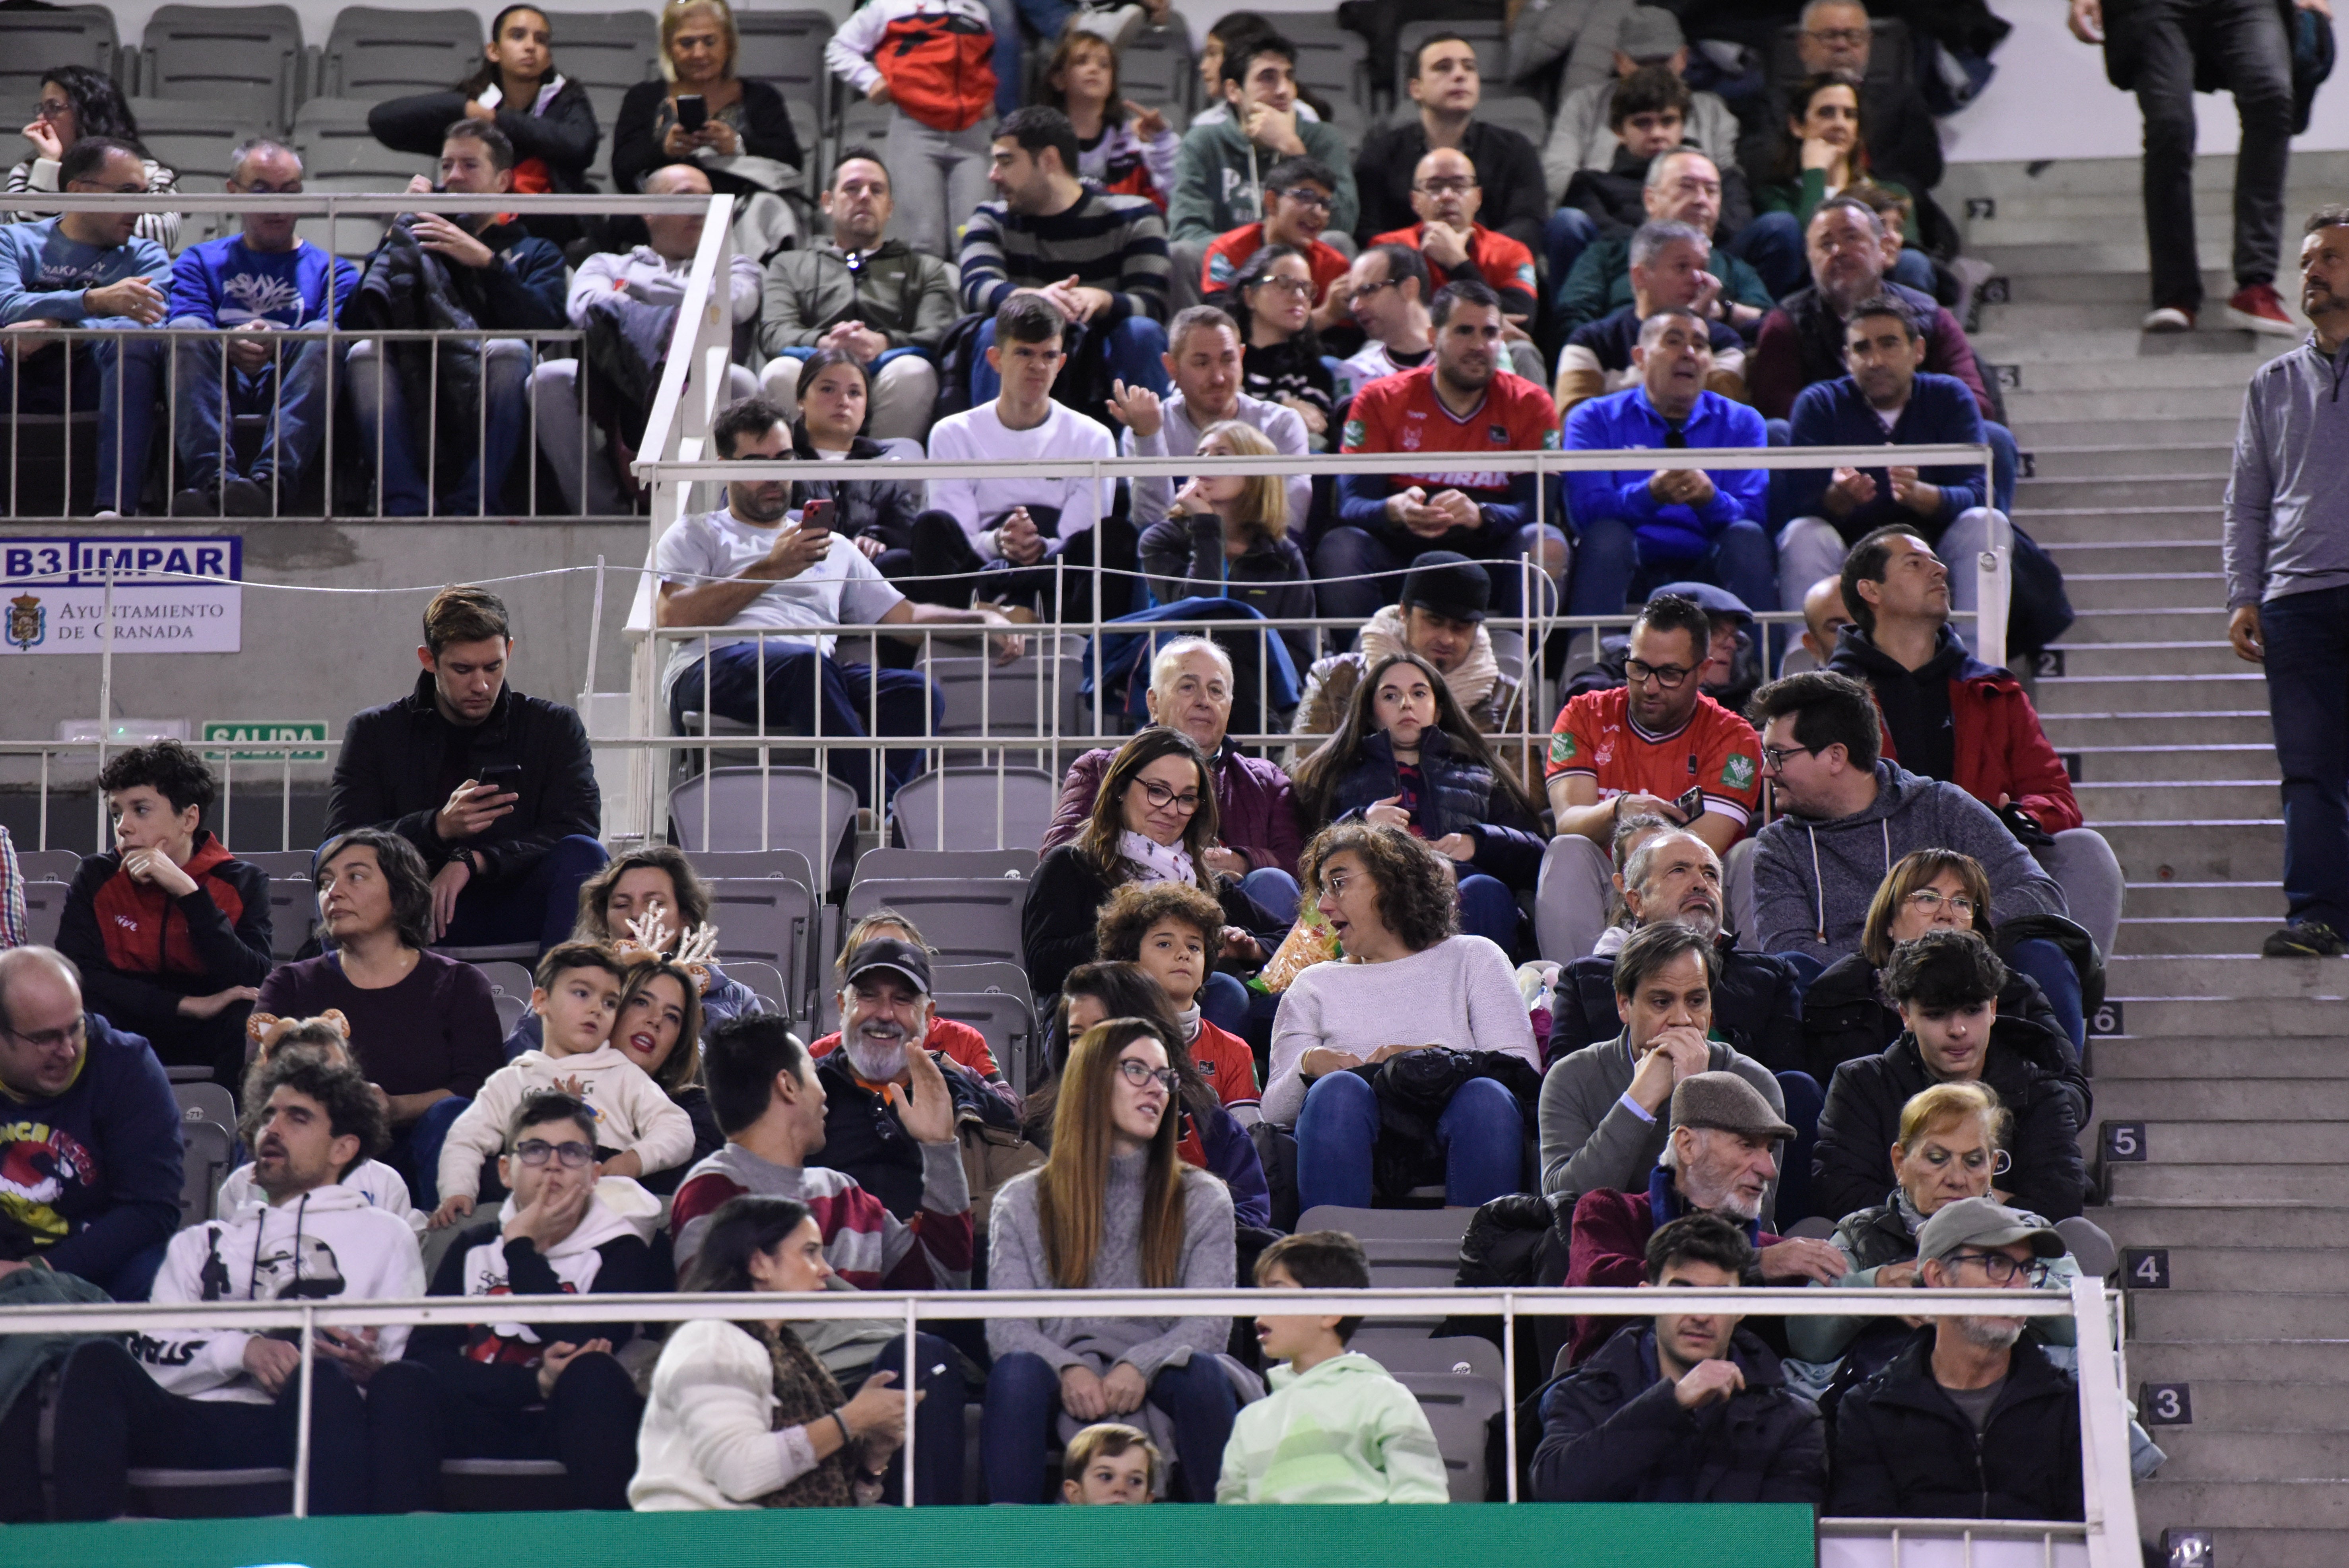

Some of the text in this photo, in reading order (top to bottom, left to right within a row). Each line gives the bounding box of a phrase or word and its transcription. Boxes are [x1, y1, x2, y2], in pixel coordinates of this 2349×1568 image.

[6, 548, 225, 576] B3 IMPAR
[2039, 652, 2057, 675] 2
[213, 728, 316, 755] SALIDA
[2094, 1005, 2115, 1032] 6
[2114, 1128, 2137, 1155] 5
[2136, 1256, 2160, 1283] 4
[1455, 1366, 1468, 1374] 59
[2157, 1389, 2181, 1419] 3
[2180, 1538, 2203, 1568] 2
